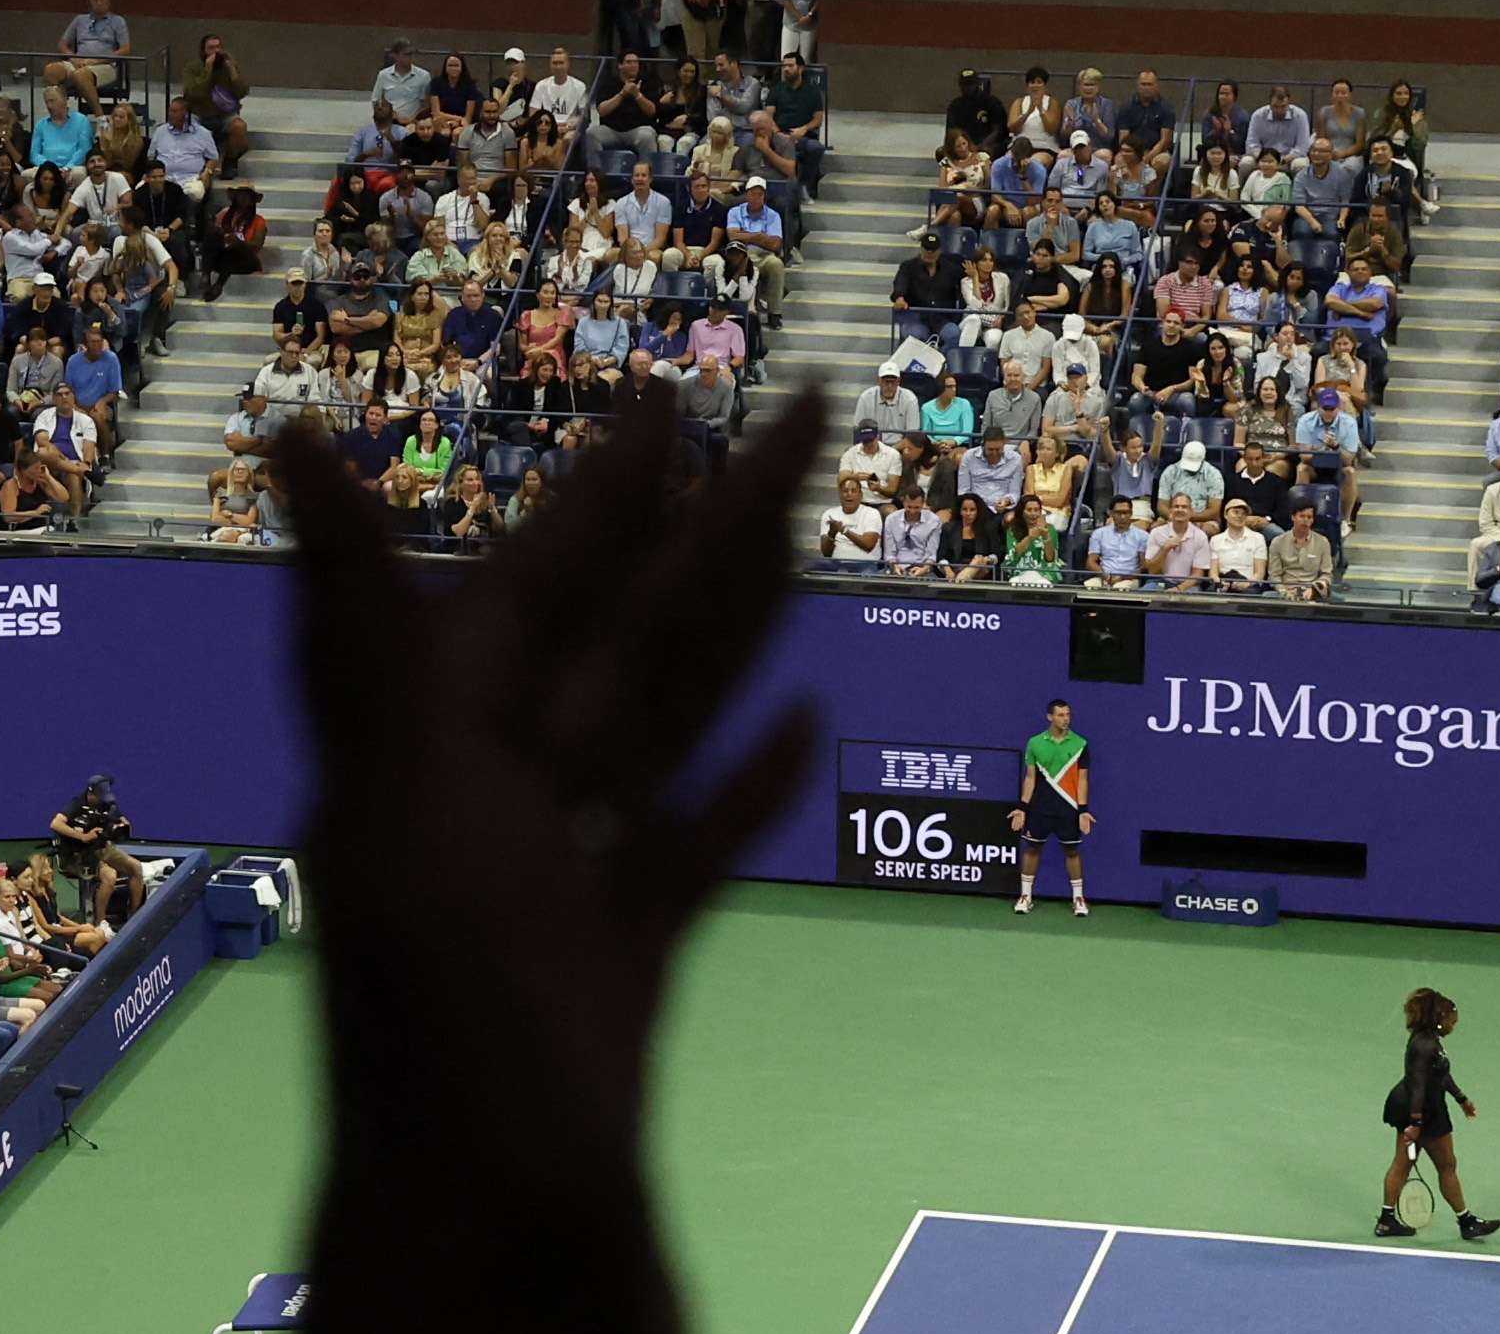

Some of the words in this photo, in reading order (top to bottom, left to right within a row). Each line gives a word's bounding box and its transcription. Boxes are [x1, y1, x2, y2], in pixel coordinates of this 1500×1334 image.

[865, 607, 1000, 630] USOPEN.ORG
[882, 751, 971, 791] IBM
[850, 809, 953, 861] 106
[966, 843, 1017, 865] MPH
[875, 860, 925, 878] SERVE
[931, 864, 981, 881] SPEED
[1176, 895, 1238, 911] CHASE
[114, 956, 172, 1039] moderna
